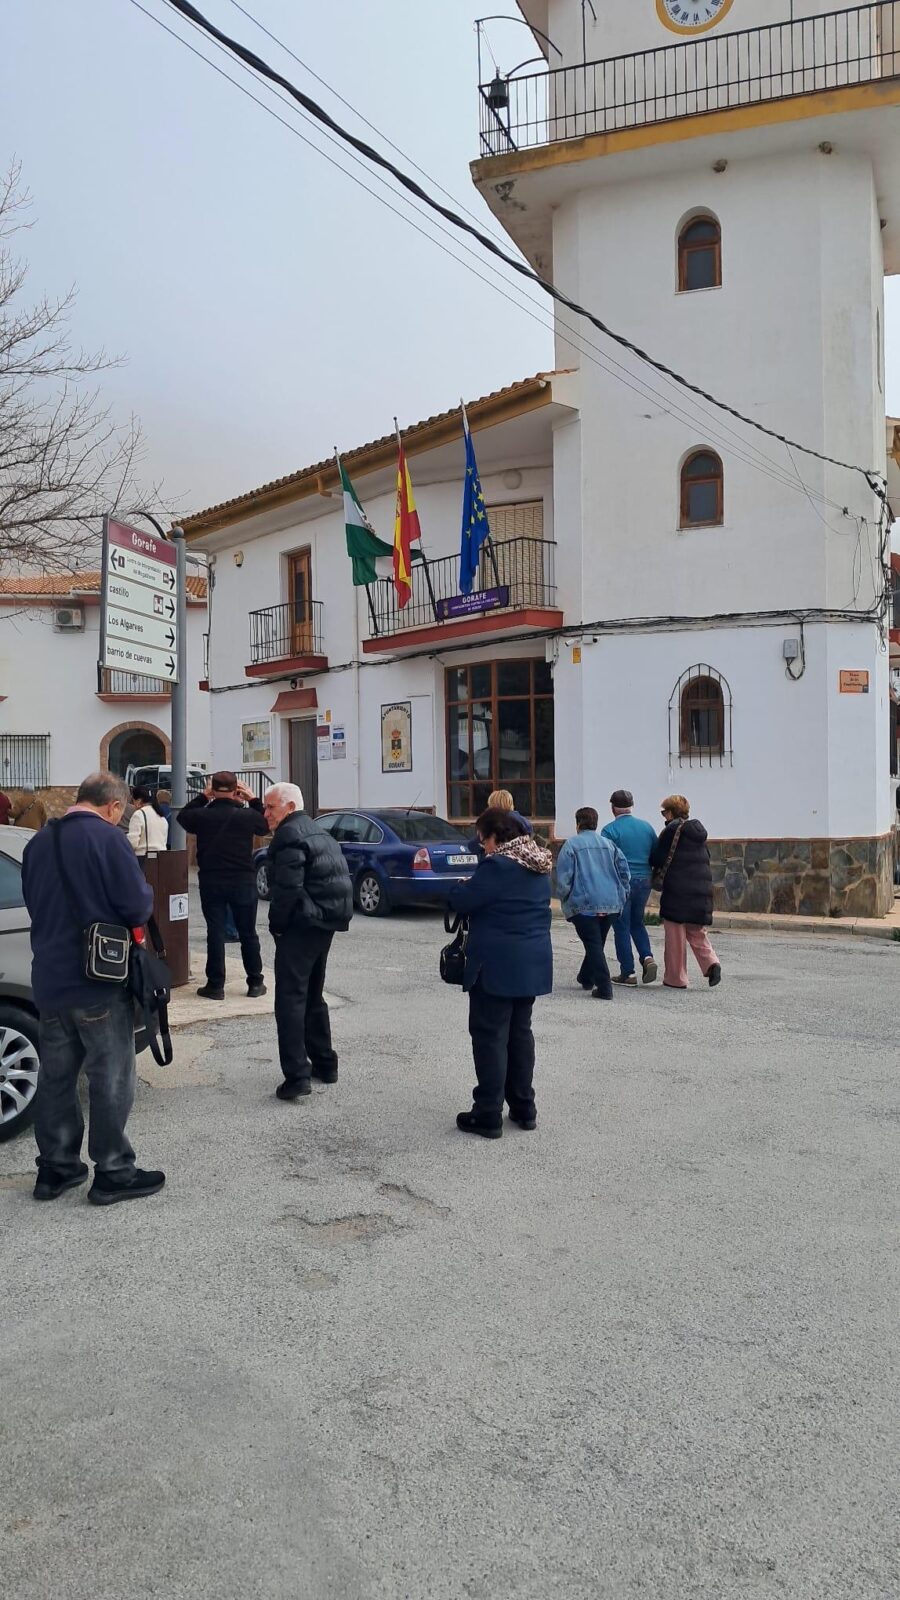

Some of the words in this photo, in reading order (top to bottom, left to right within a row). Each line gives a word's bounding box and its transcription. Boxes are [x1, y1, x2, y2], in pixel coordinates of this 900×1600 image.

[132, 532, 157, 553] Gorafe
[109, 585, 129, 598] castillo
[462, 592, 487, 604] GORAFE
[108, 614, 119, 626] Los
[120, 618, 144, 633] Algarves
[107, 645, 124, 658] barrio
[125, 651, 132, 660] de
[133, 653, 152, 664] cuevas
